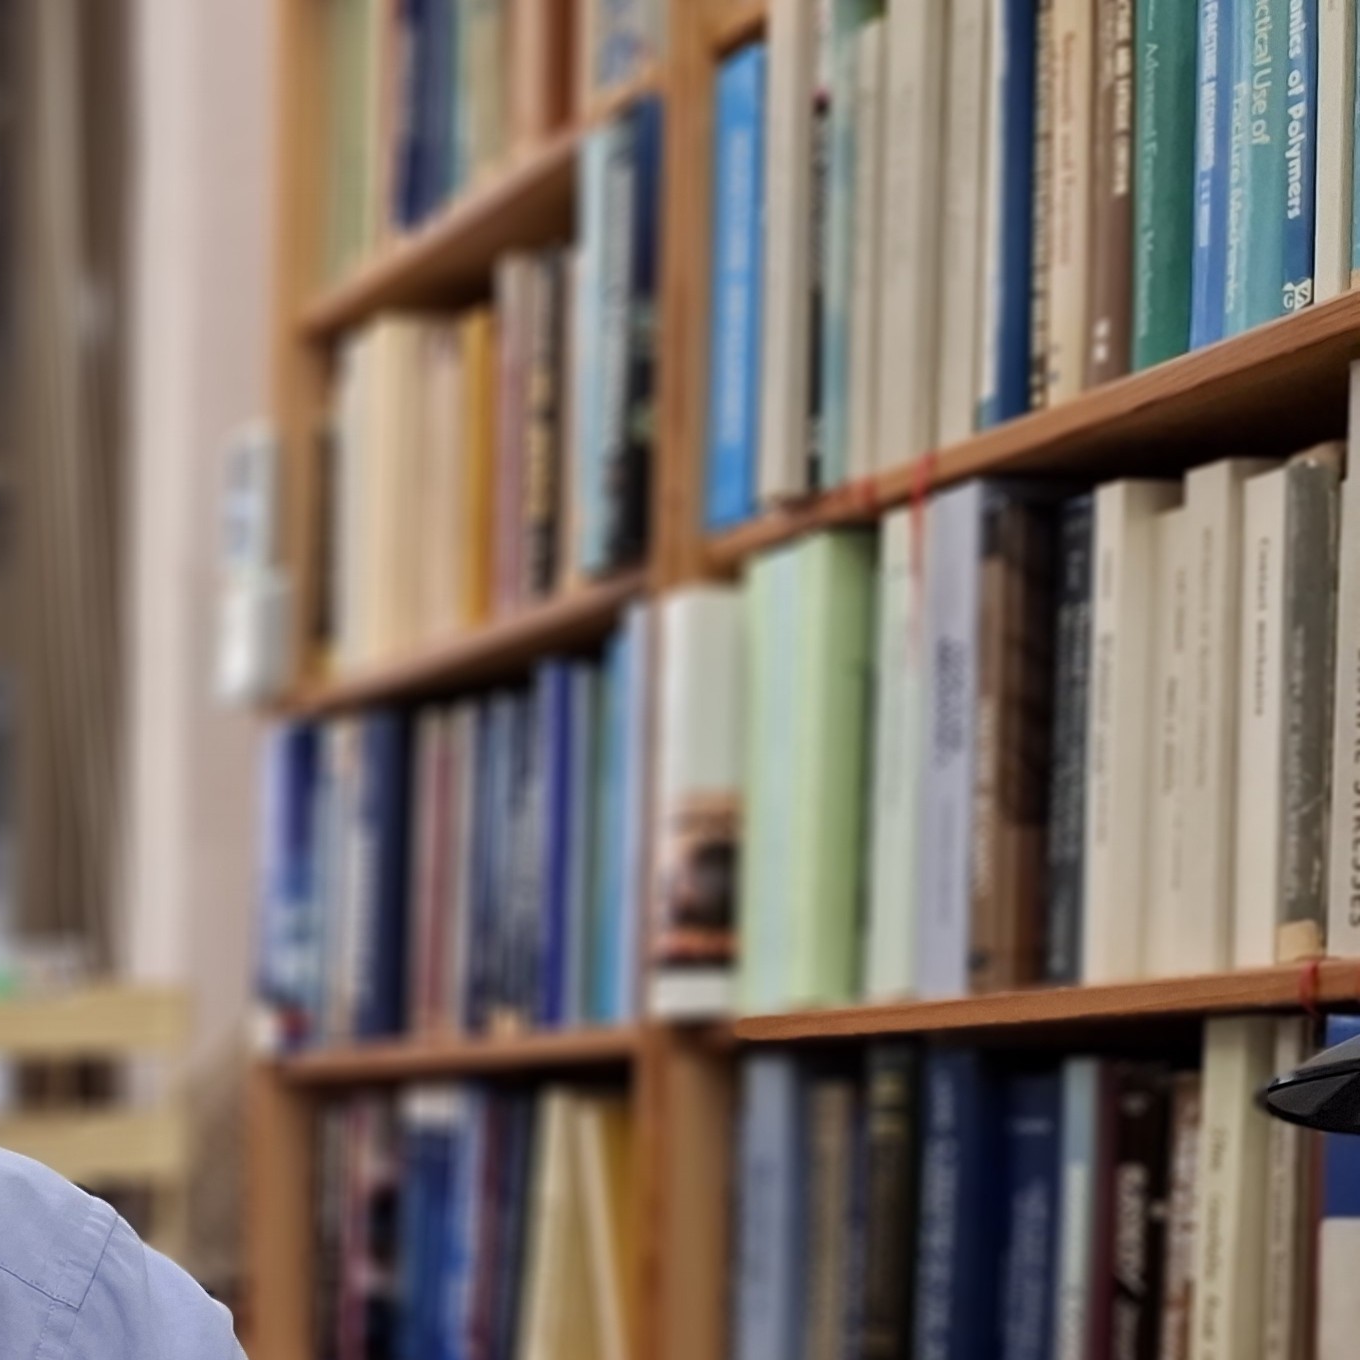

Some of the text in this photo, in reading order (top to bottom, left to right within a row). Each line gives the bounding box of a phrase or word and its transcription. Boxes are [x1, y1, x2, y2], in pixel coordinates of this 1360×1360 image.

[1142, 43, 1159, 139] Advanced
[1251, 0, 1272, 145] ctical Use of
[1287, 69, 1305, 97] of
[1225, 81, 1249, 315] Fracture Mechanics
[1285, 101, 1307, 220] Polymers
